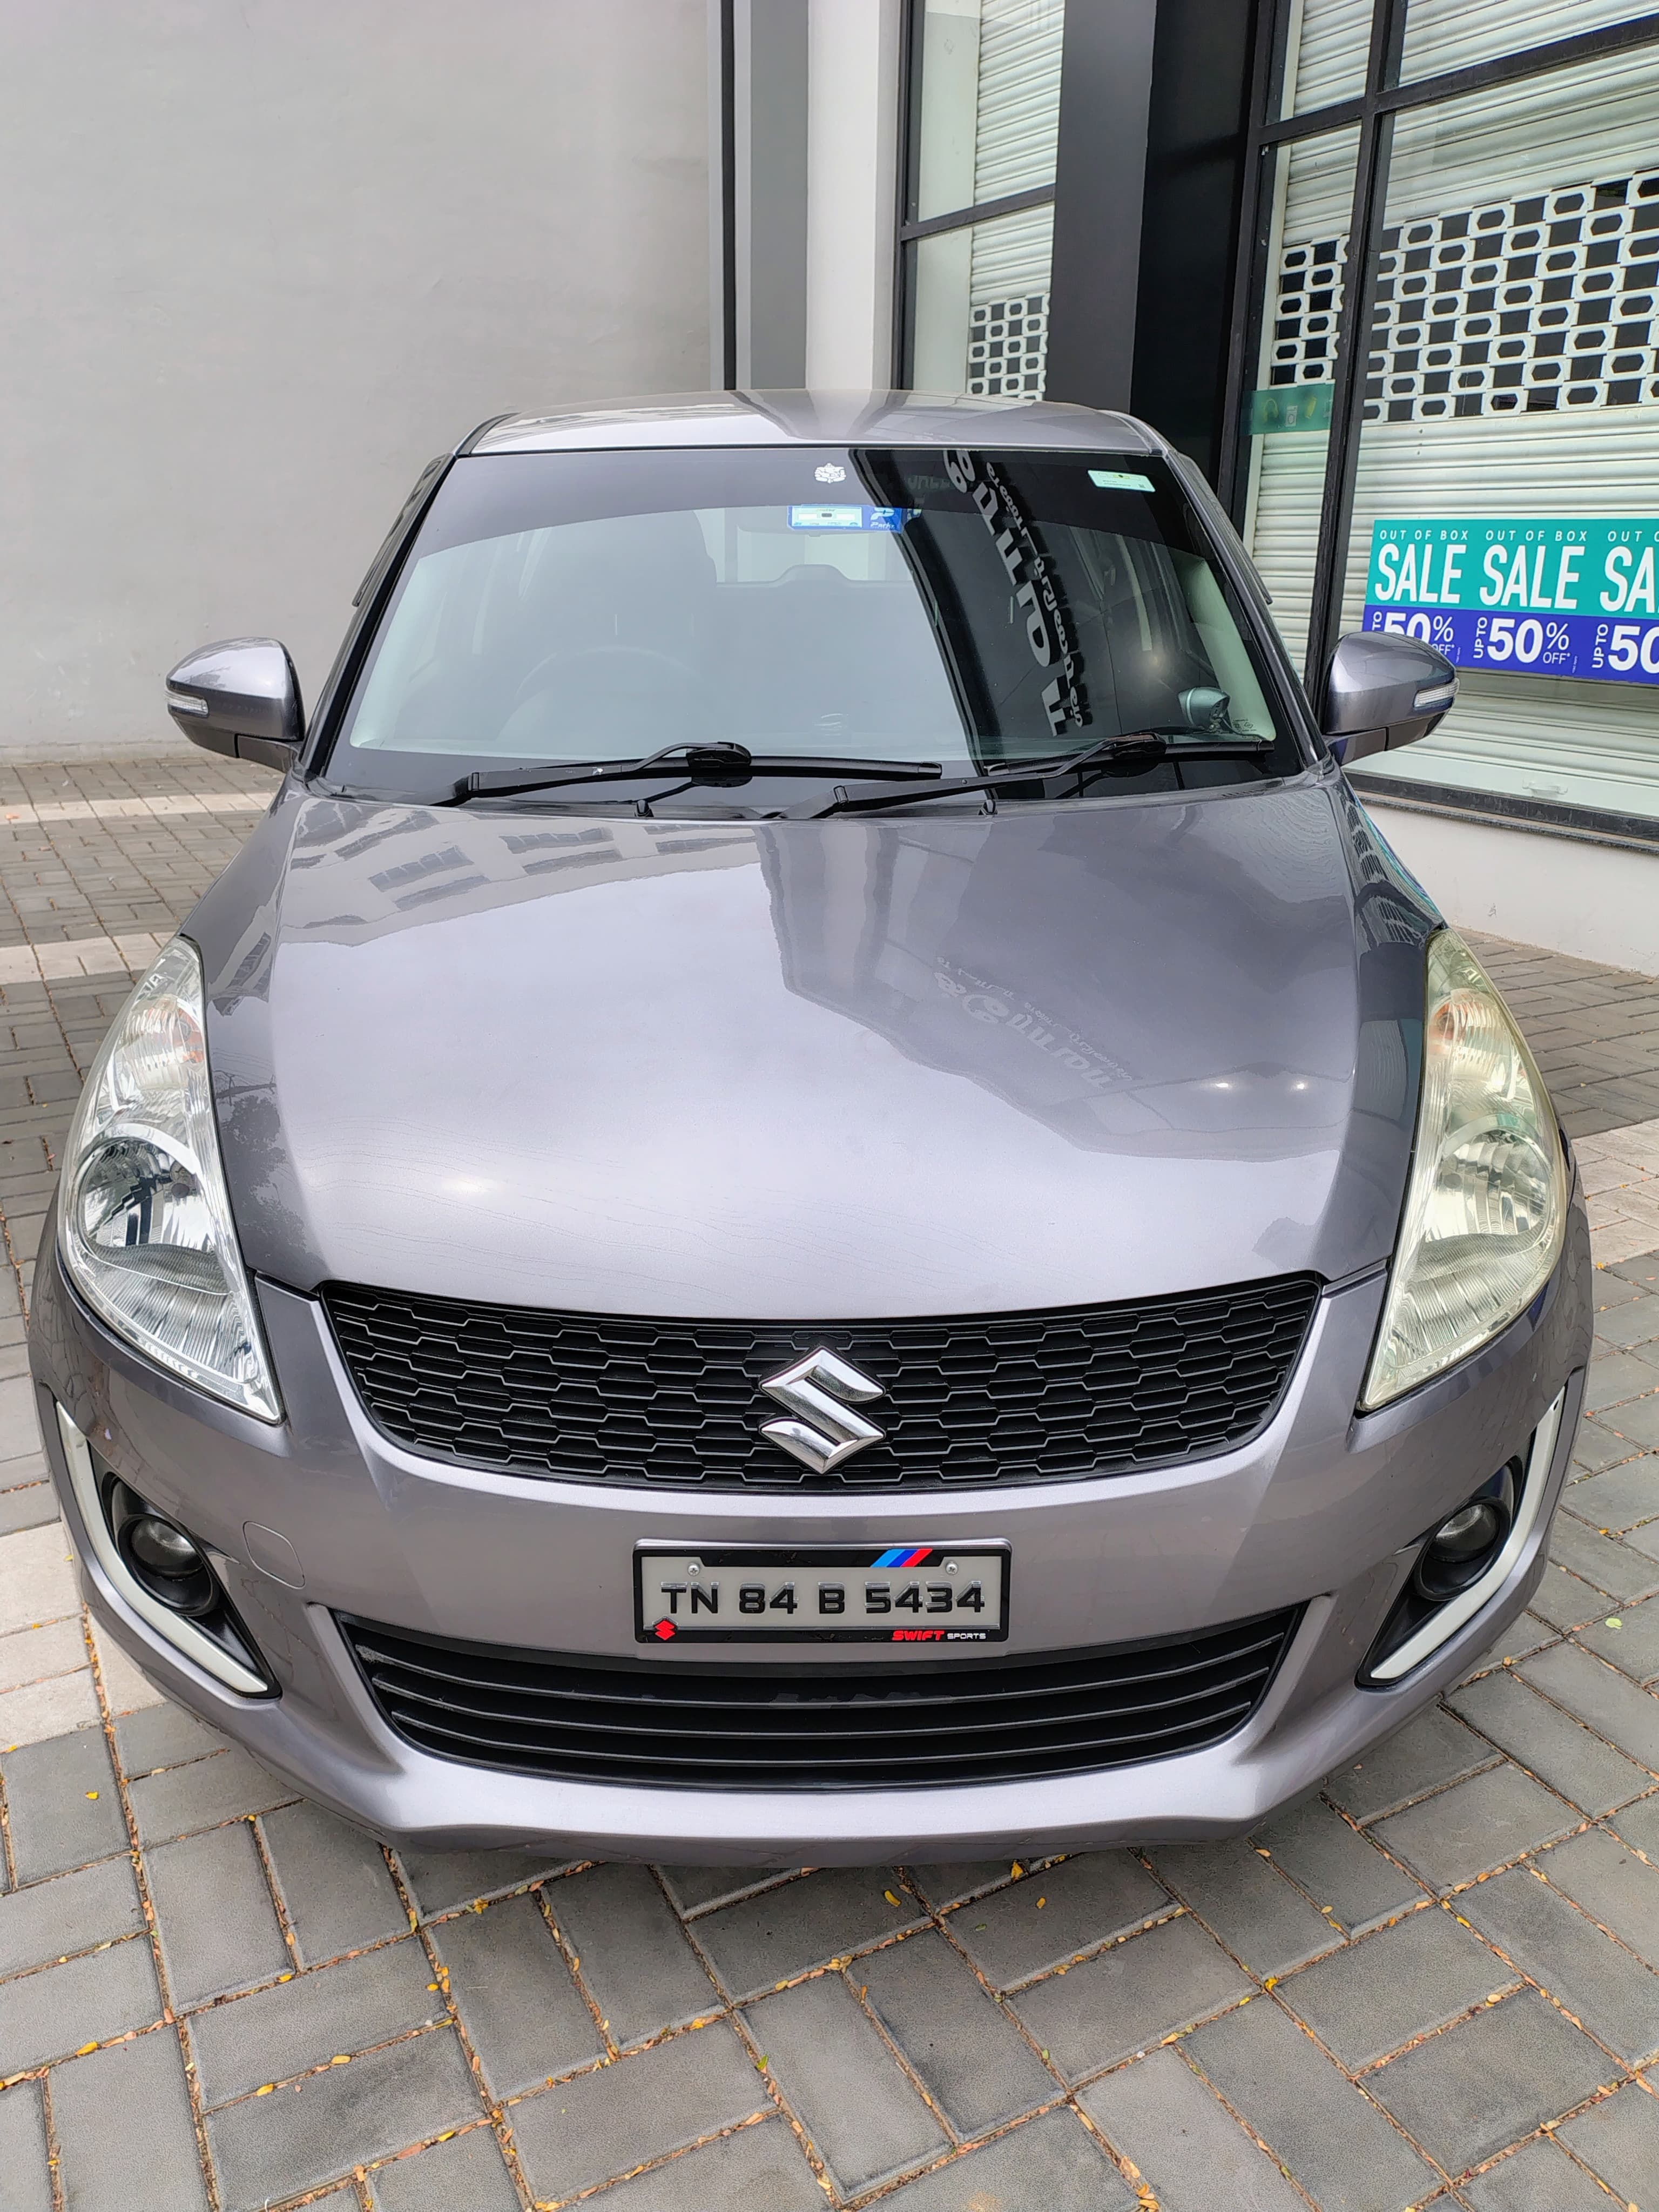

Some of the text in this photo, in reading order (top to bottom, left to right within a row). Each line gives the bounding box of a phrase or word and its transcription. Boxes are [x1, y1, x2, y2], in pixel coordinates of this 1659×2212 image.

[1379, 530, 1469, 541] OUT OF BOX
[1485, 530, 1588, 542] OUT OF BOX
[1607, 531, 1643, 542] OUT
[1374, 543, 1467, 604] SALE
[1479, 544, 1586, 610] SALE
[1600, 545, 1659, 613] SA
[660, 1581, 985, 1614] TN 84 B 5434
[892, 1629, 945, 1641] SWIFT
